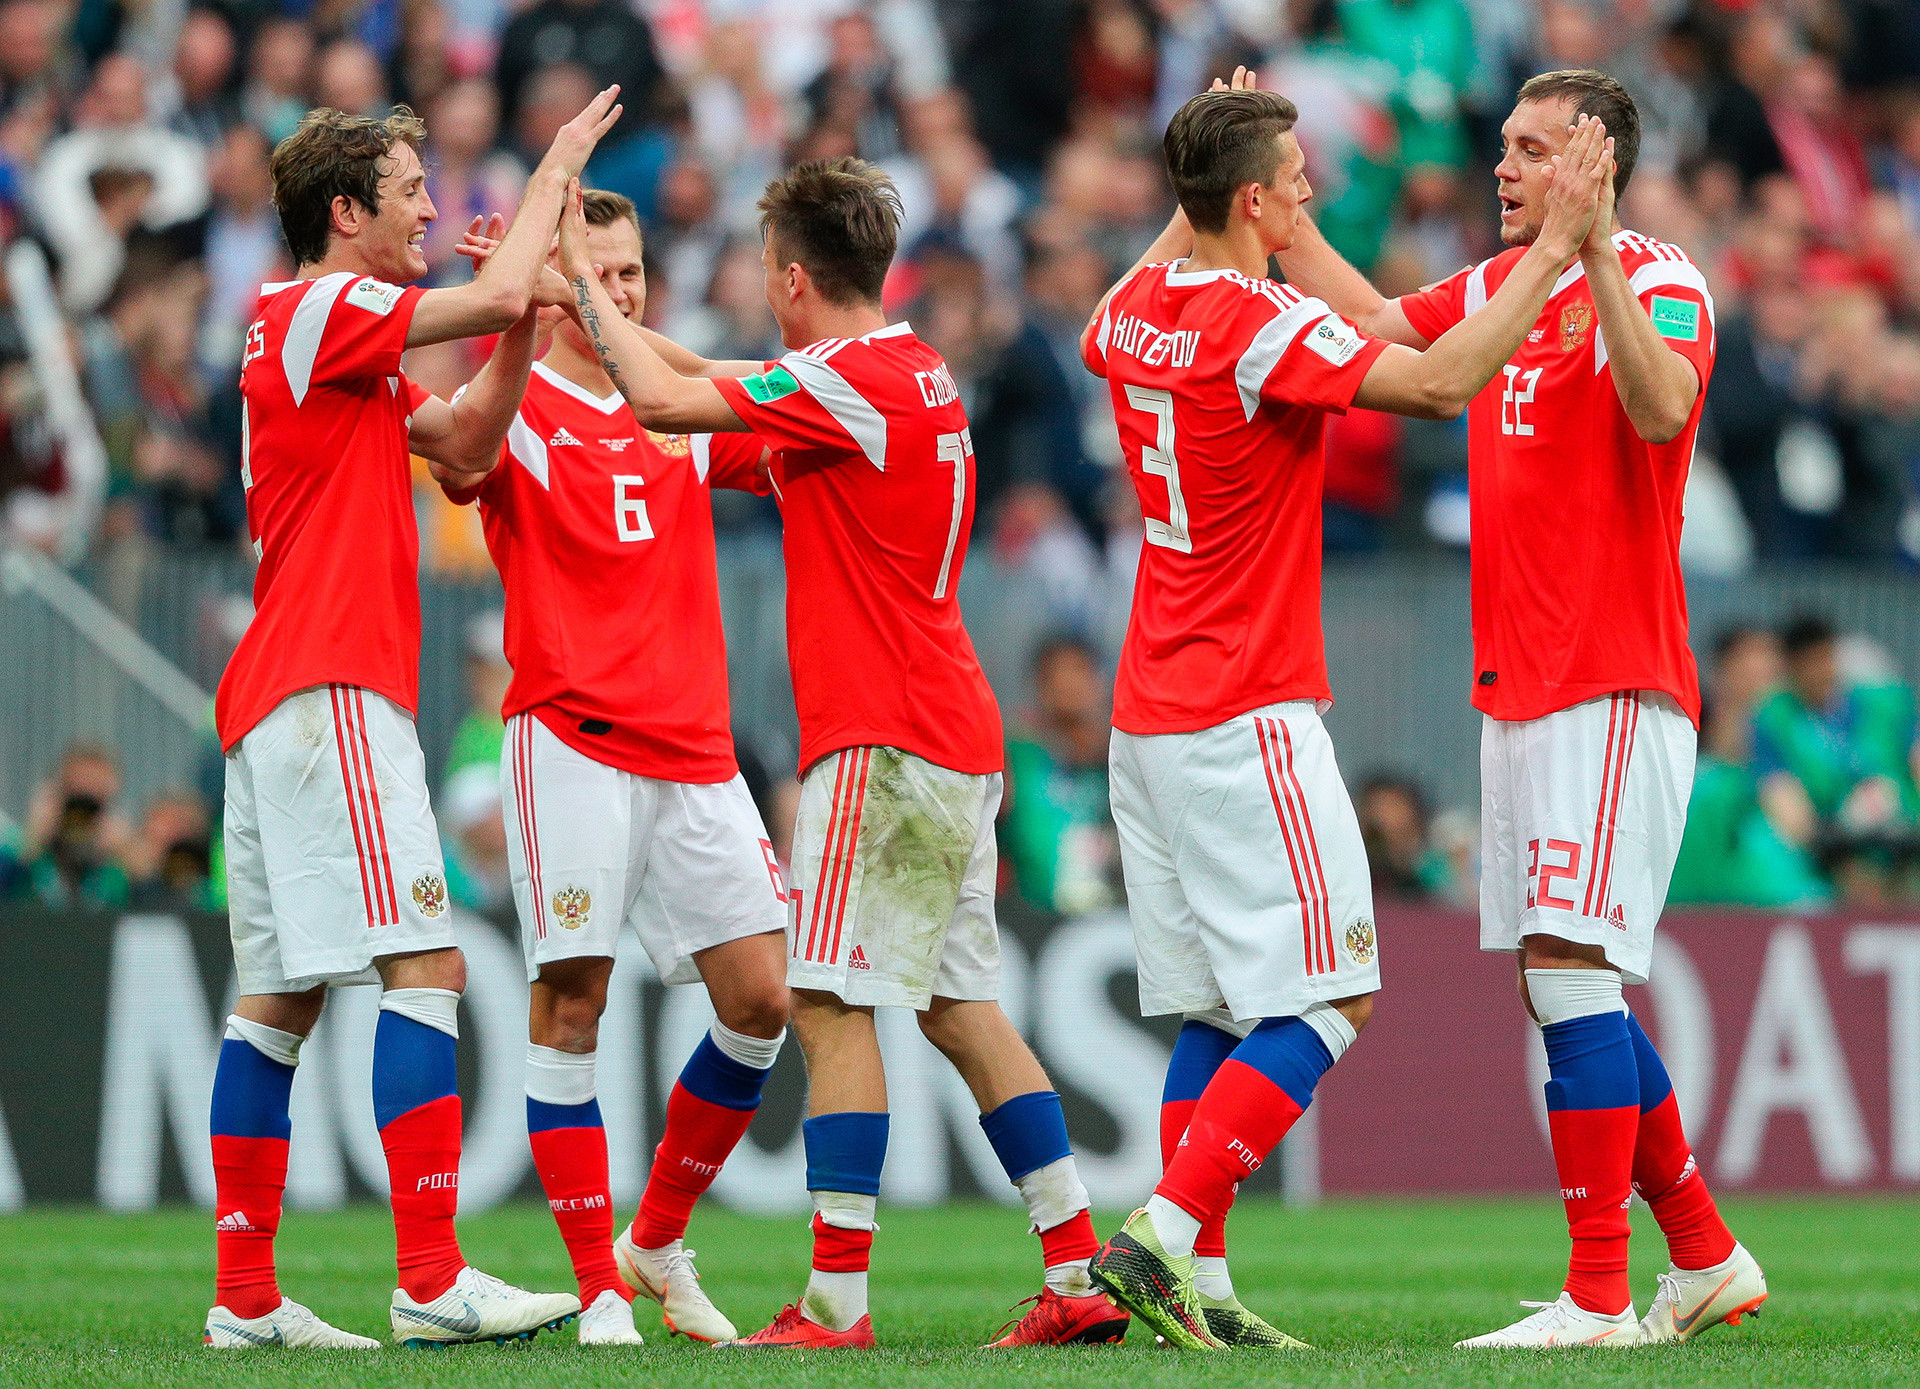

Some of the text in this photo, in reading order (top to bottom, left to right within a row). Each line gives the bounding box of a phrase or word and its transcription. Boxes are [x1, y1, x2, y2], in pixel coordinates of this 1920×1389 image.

[1111, 310, 1201, 368] KUTEPOV
[1502, 364, 1543, 436] 22
[1123, 383, 1193, 554] 3
[613, 475, 655, 542] 6
